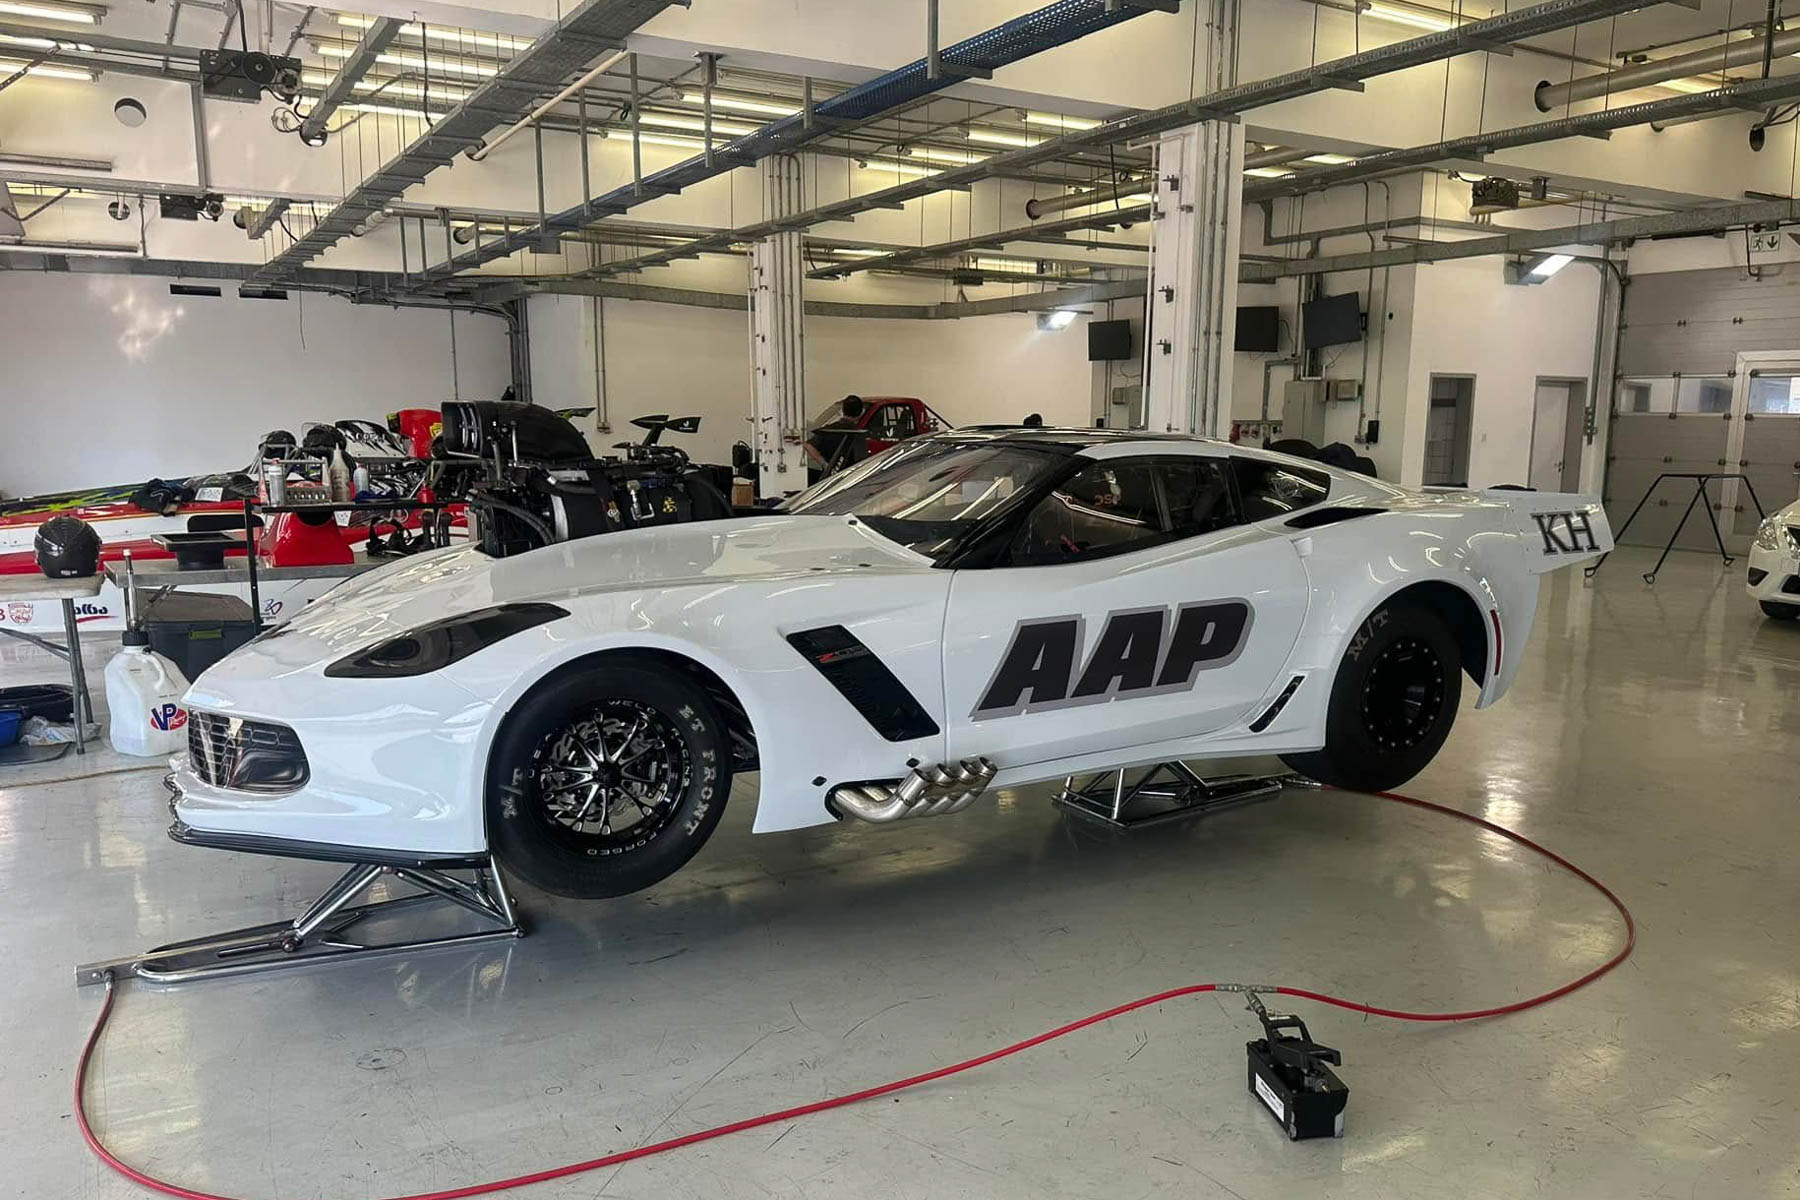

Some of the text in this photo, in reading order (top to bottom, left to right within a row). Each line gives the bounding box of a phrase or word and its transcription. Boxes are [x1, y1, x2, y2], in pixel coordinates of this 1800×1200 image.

[1530, 511, 1600, 555] KH
[1347, 608, 1389, 661] M/T
[968, 597, 1256, 722] AAP
[151, 703, 177, 731] VP
[608, 700, 656, 715] WELD
[679, 704, 717, 836] ET FRONT
[587, 831, 657, 856] FORGED
